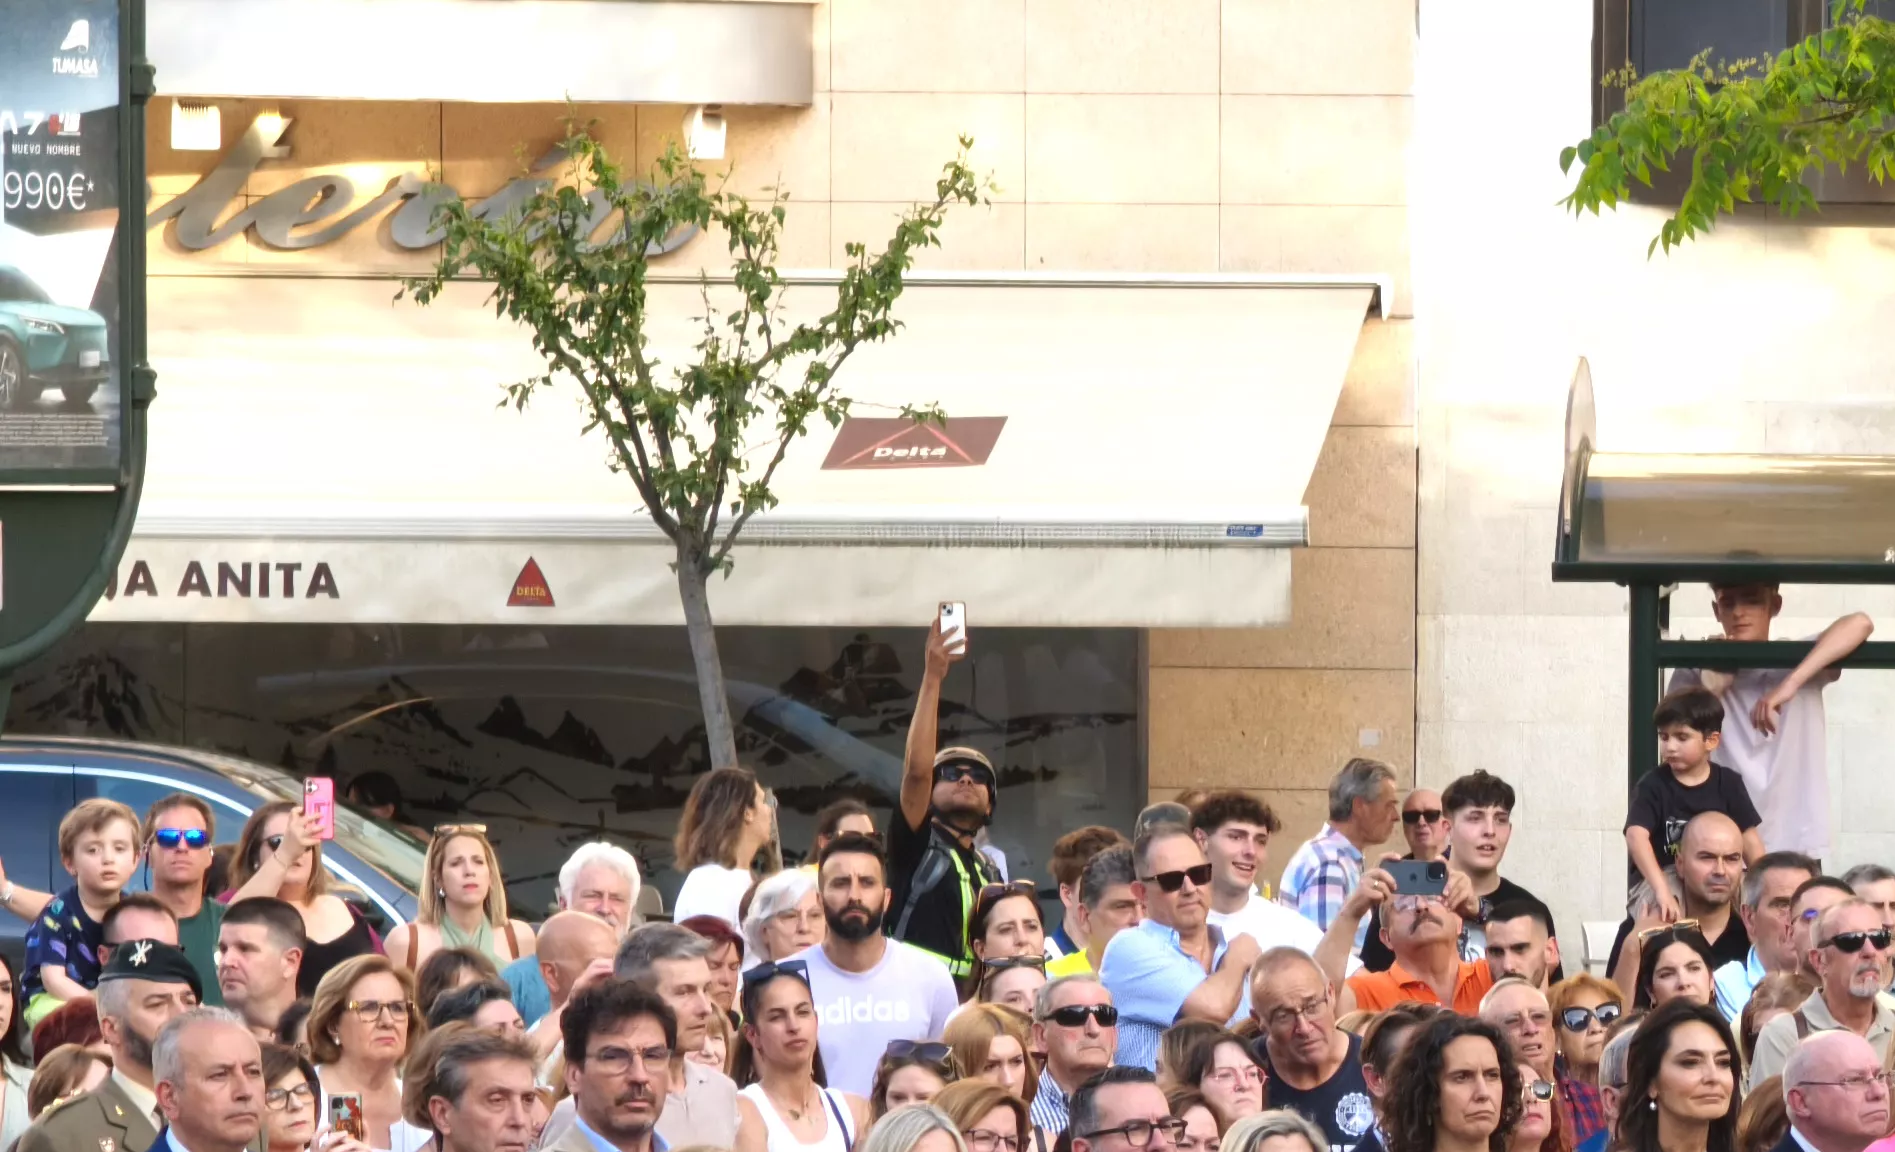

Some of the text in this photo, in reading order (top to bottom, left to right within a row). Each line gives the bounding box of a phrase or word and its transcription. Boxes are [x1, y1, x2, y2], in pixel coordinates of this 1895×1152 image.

[12, 144, 81, 156] NUEVO NOMBRE
[177, 560, 341, 599] ANITA
